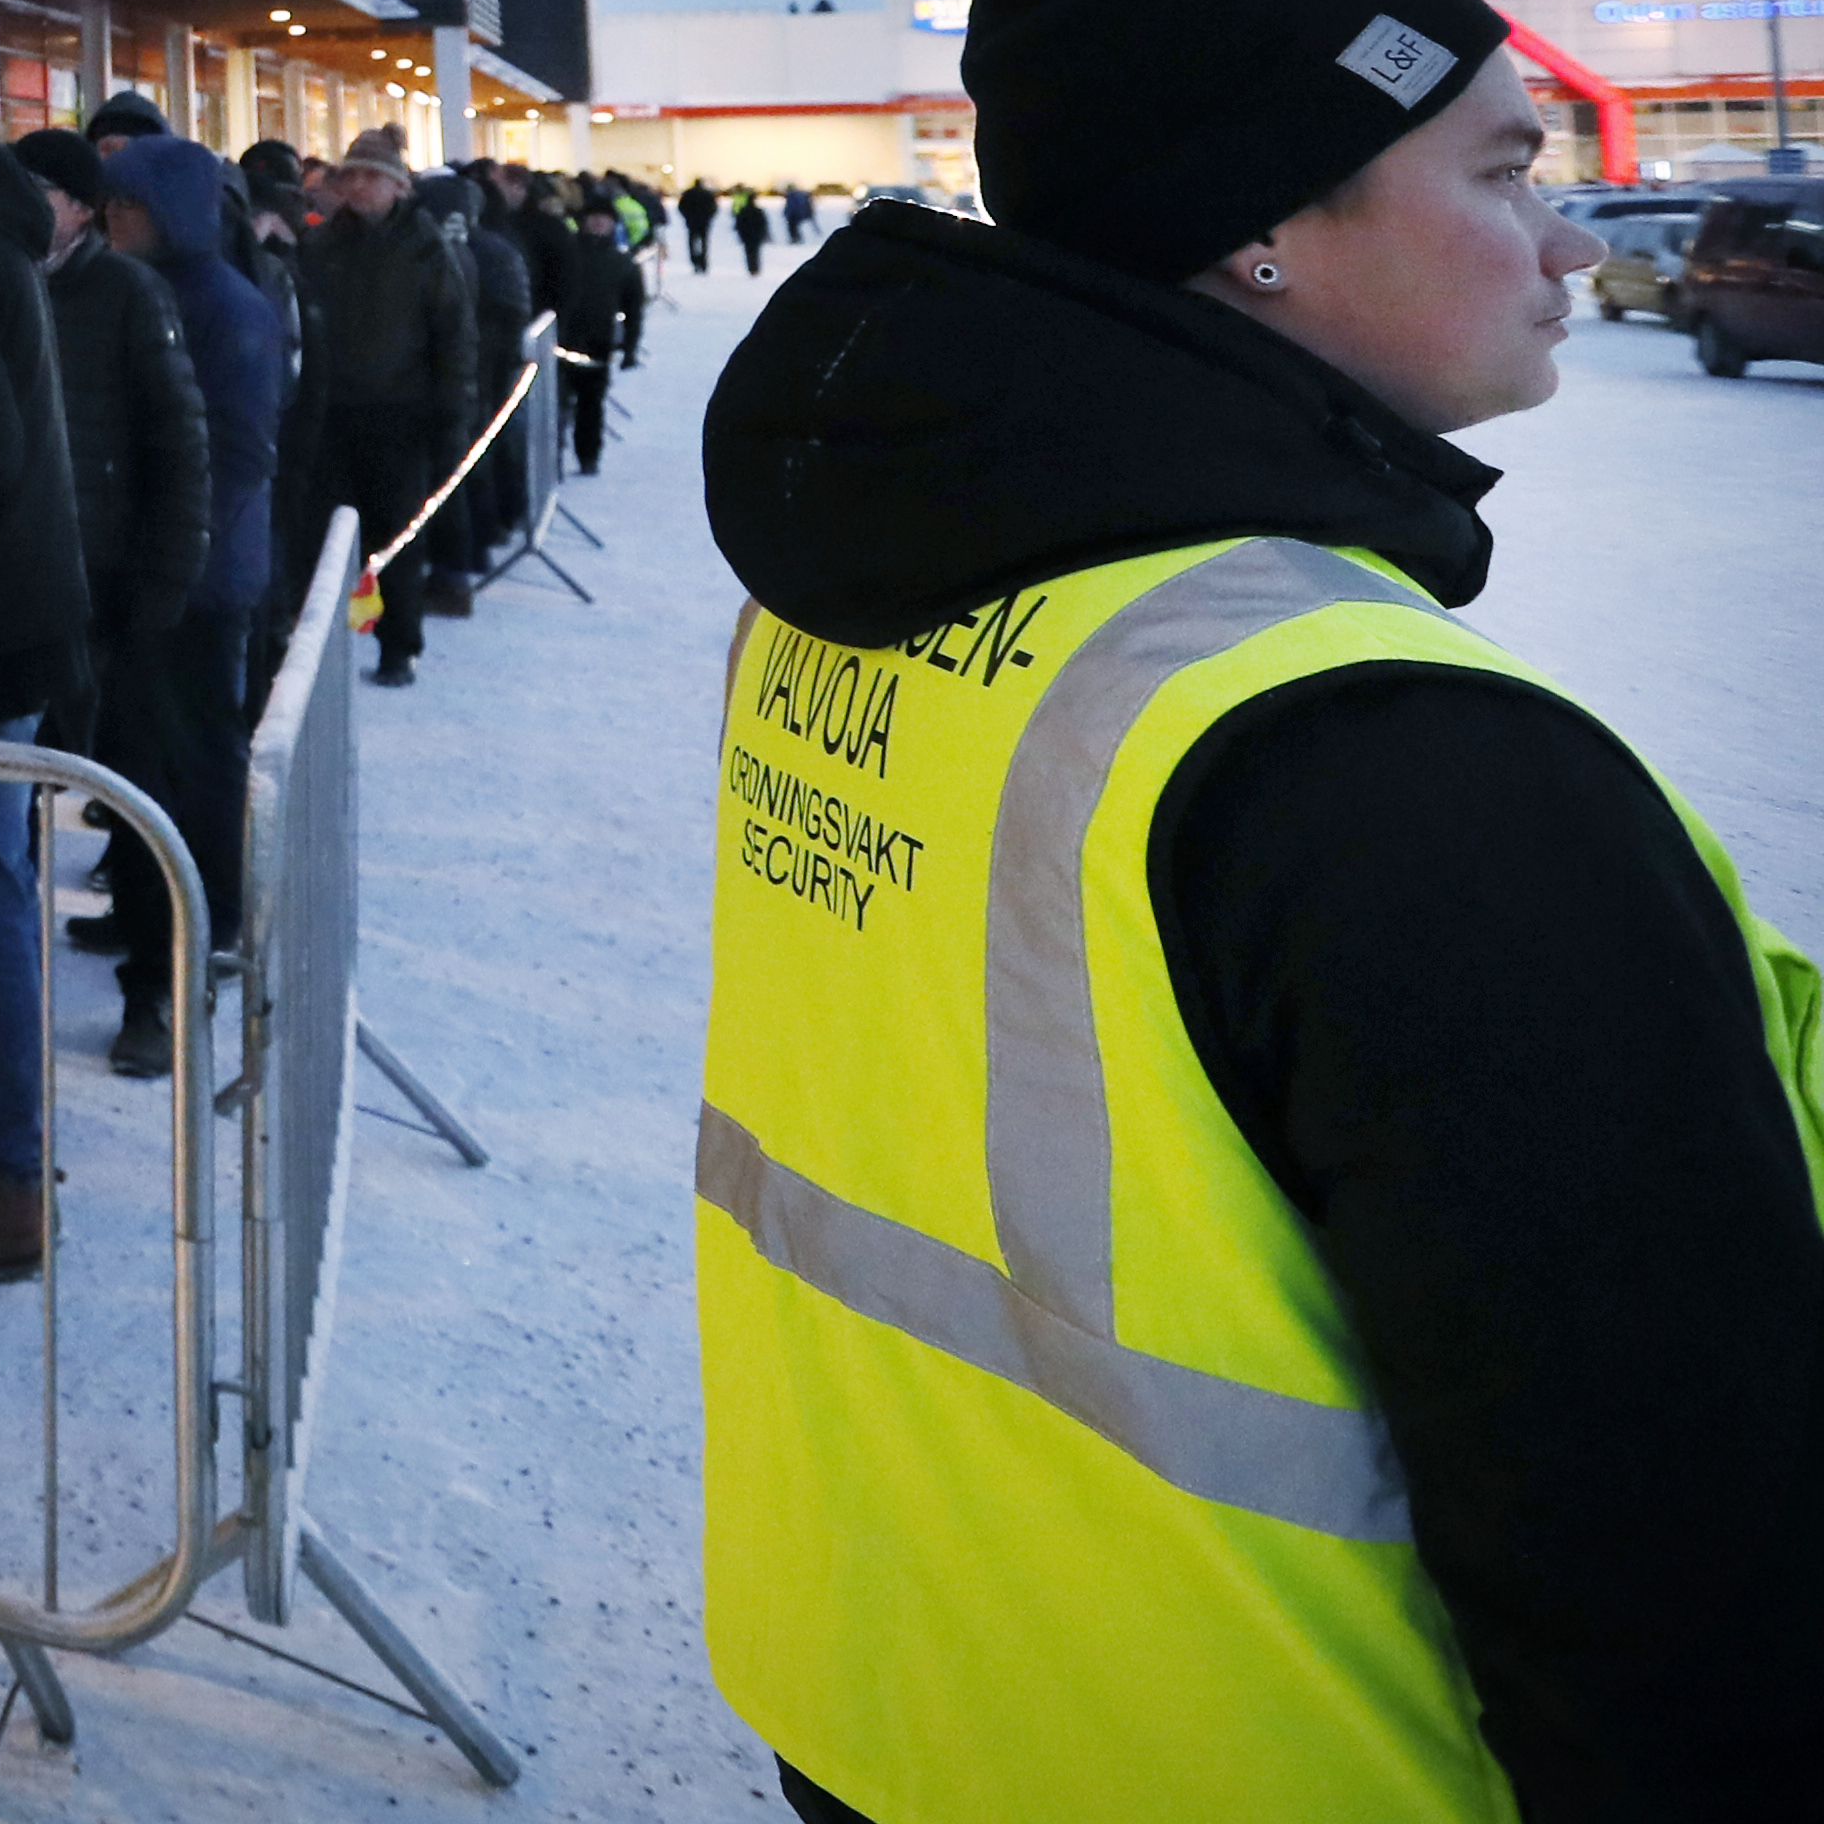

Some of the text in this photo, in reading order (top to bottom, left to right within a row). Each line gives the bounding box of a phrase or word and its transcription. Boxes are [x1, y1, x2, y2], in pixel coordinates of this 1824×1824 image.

[1370, 32, 1424, 84] L&F
[756, 624, 900, 780] VALVOJA
[741, 817, 875, 932] SECURITY
